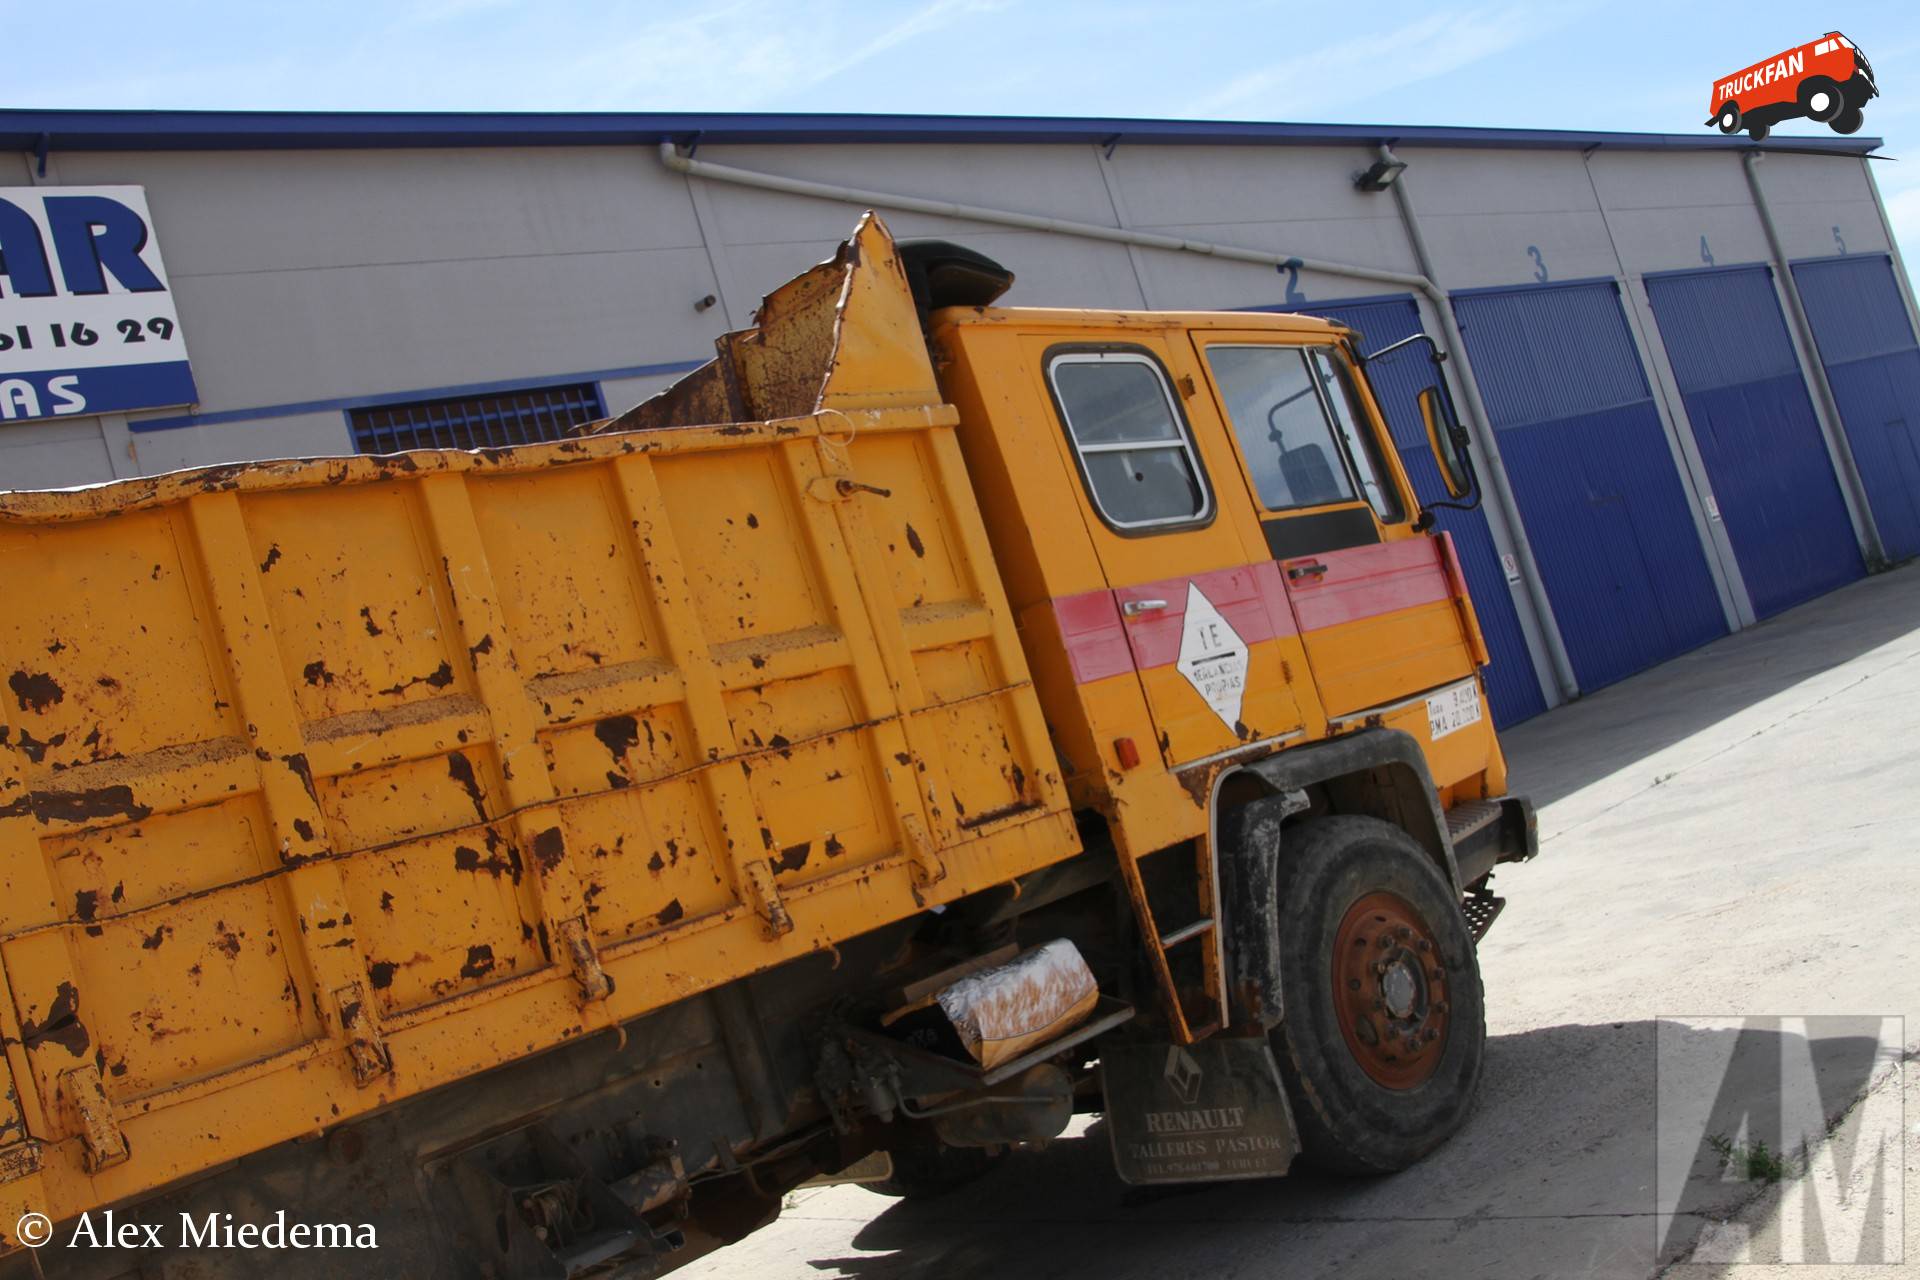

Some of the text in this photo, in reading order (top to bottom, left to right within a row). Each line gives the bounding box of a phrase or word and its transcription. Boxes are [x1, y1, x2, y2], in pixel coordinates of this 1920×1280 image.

[1701, 235, 1714, 267] 4
[1832, 226, 1847, 256] 5
[1527, 245, 1548, 283] 3
[1276, 257, 1306, 305] 2
[50, 322, 99, 347] 16
[116, 317, 174, 343] 29
[0, 375, 86, 419] AS
[1146, 1106, 1244, 1132] RENAULT
[1130, 1136, 1281, 1159] TALLERES PASTOR
